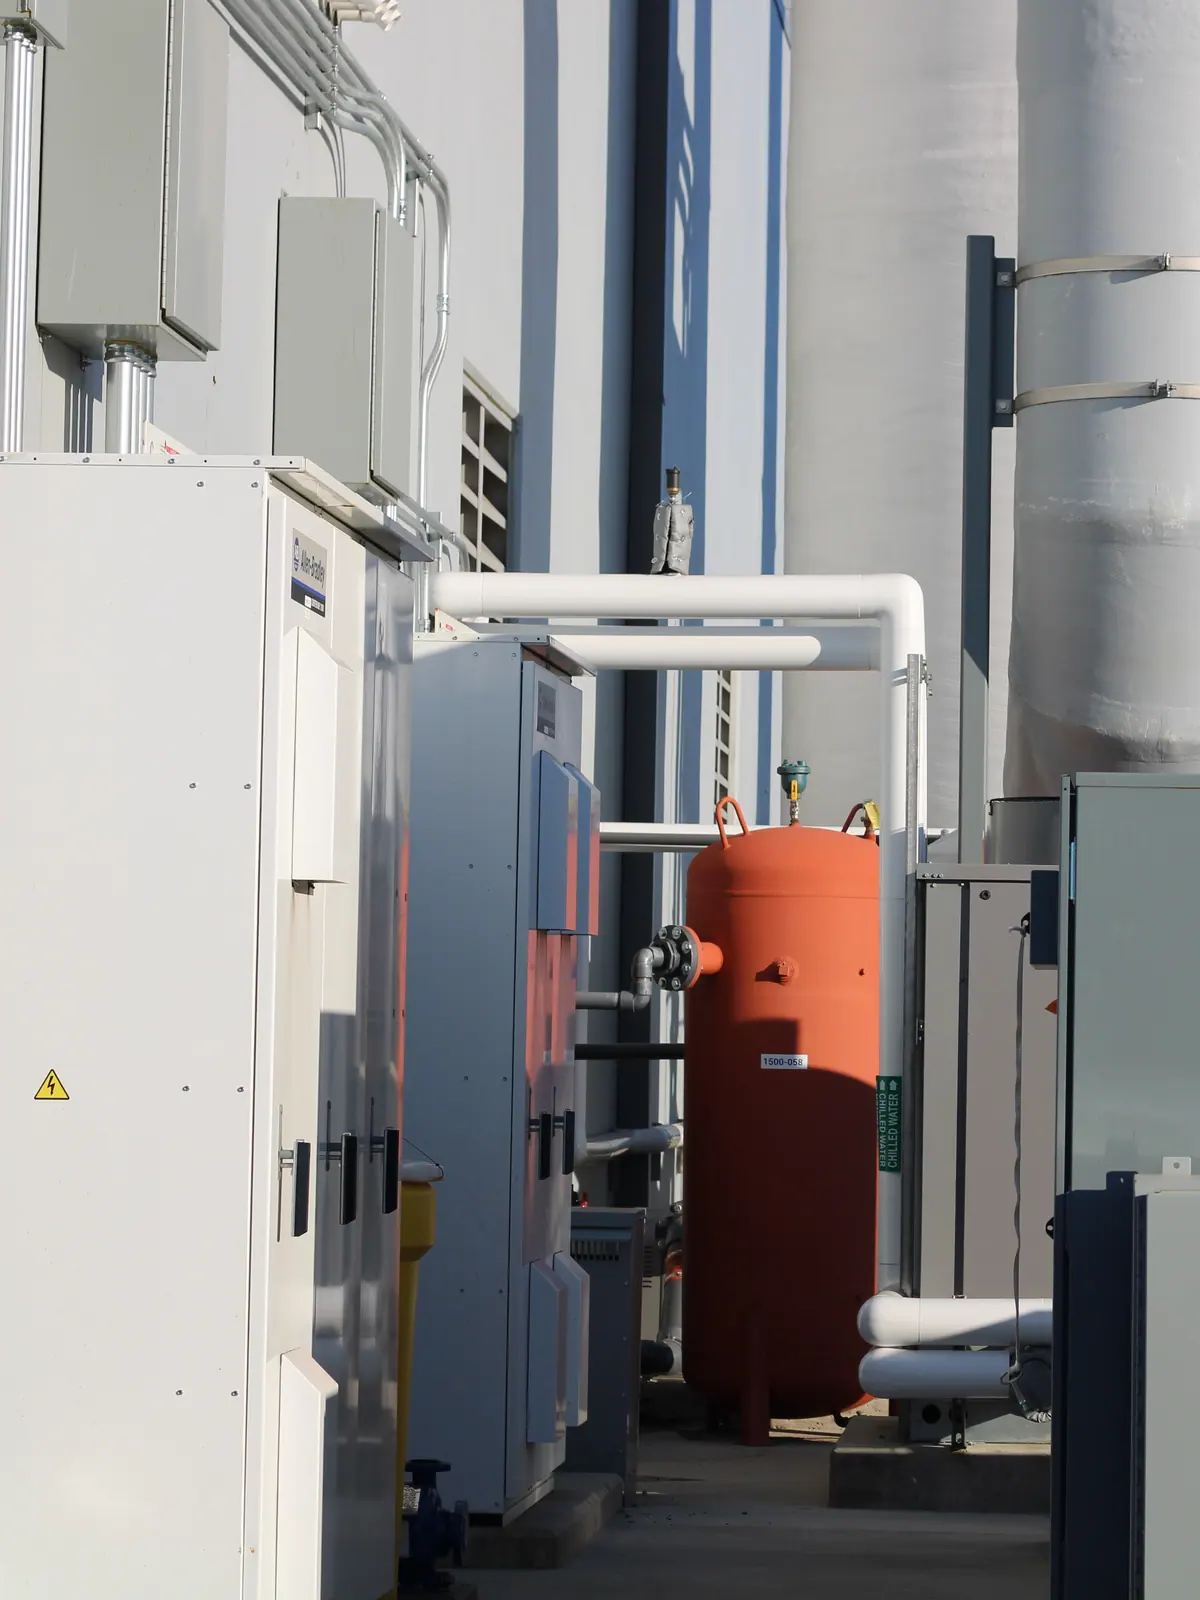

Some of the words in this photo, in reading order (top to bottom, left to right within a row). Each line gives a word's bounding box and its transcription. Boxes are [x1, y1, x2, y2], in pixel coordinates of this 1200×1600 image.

[763, 1058, 803, 1066] 1500-058
[888, 1094, 898, 1126] WATER
[888, 1128, 898, 1168] CHILLED
